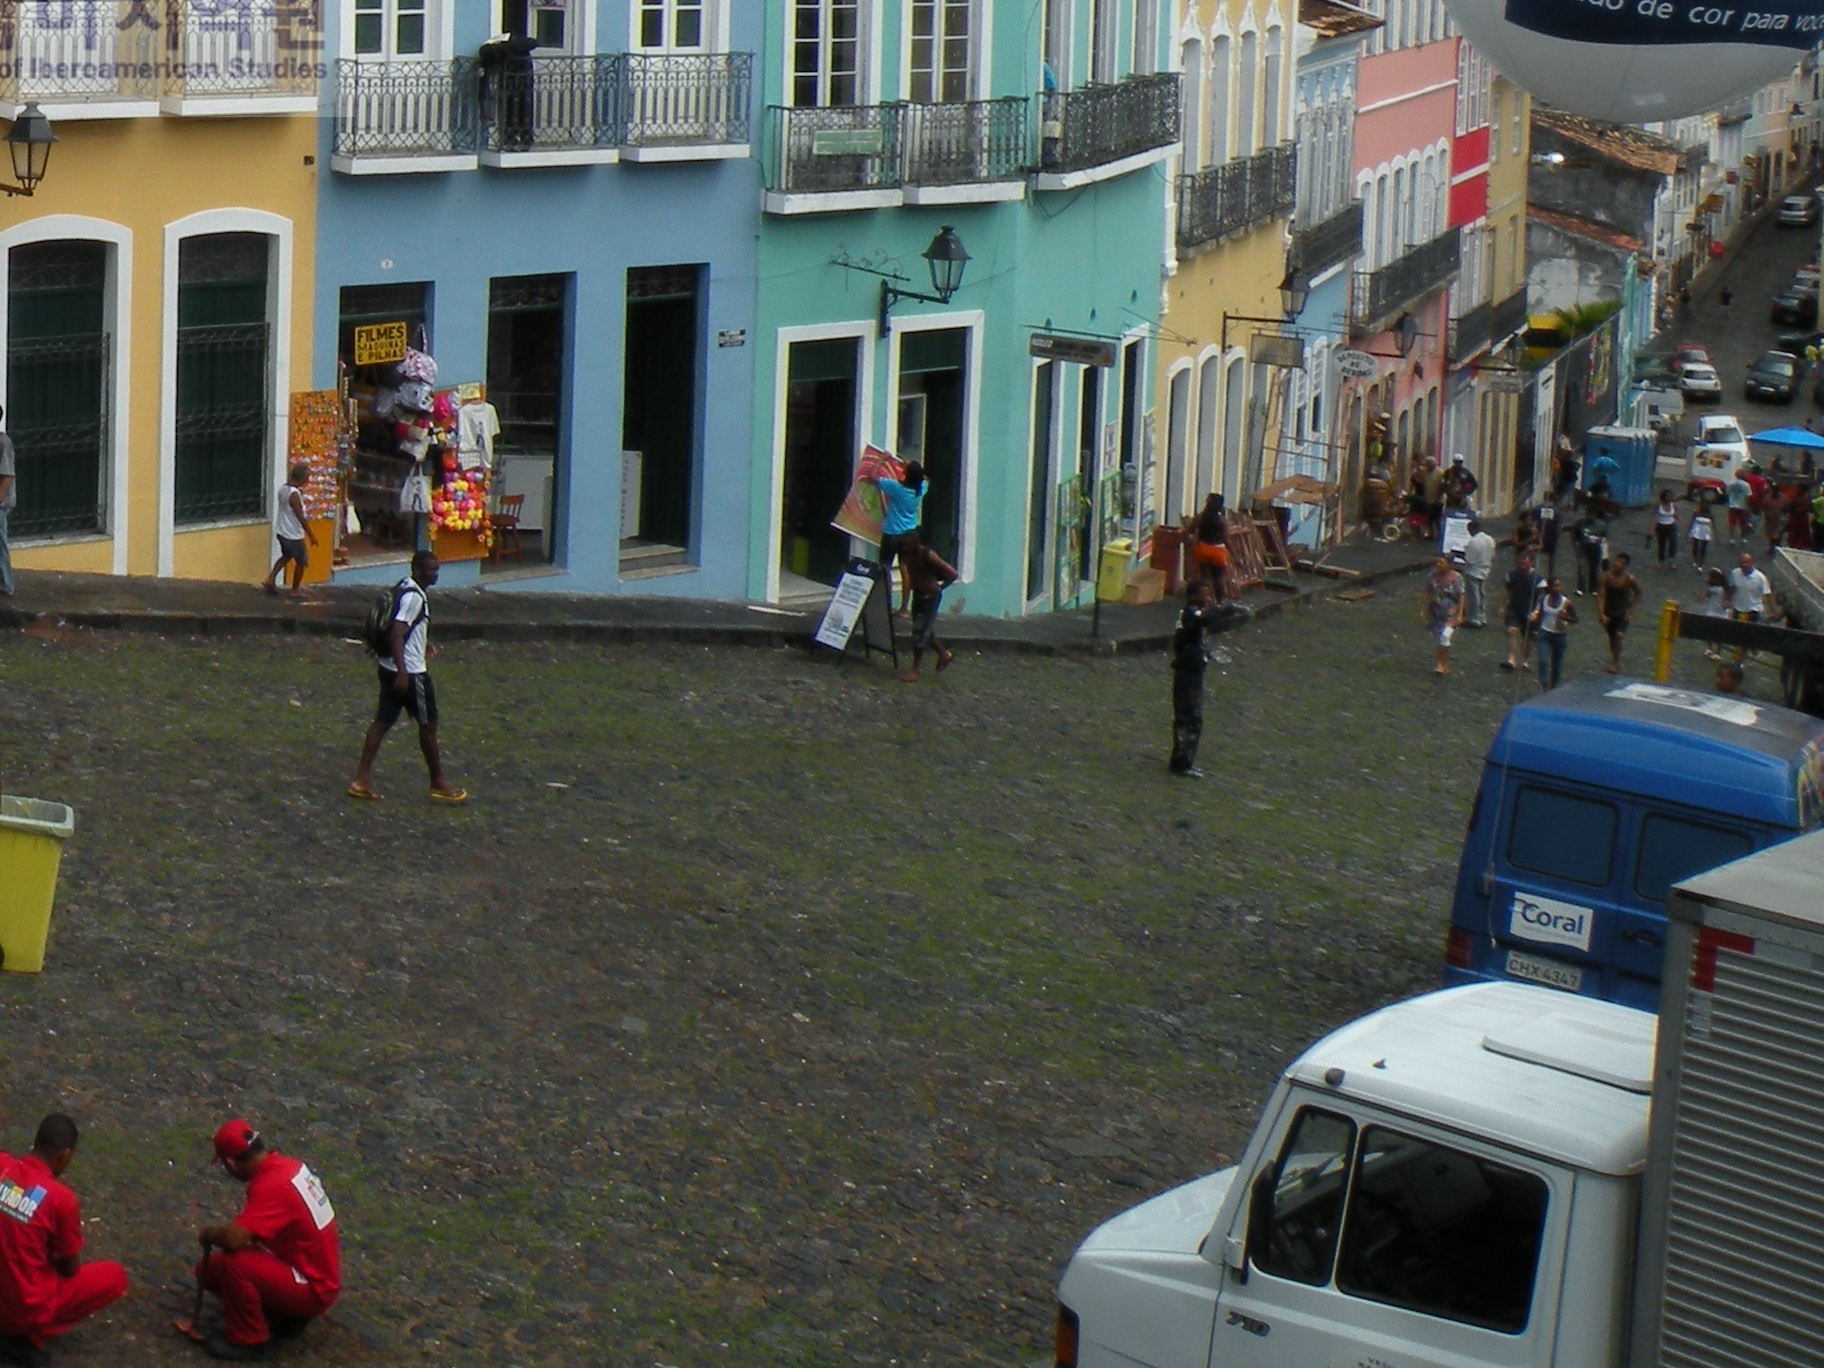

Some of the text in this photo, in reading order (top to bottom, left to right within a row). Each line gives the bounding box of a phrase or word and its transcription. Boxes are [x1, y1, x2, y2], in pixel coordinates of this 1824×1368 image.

[1688, 6, 1736, 25] cor
[1740, 11, 1789, 32] para
[357, 325, 405, 343] FILMES
[1521, 903, 1584, 934] Coral
